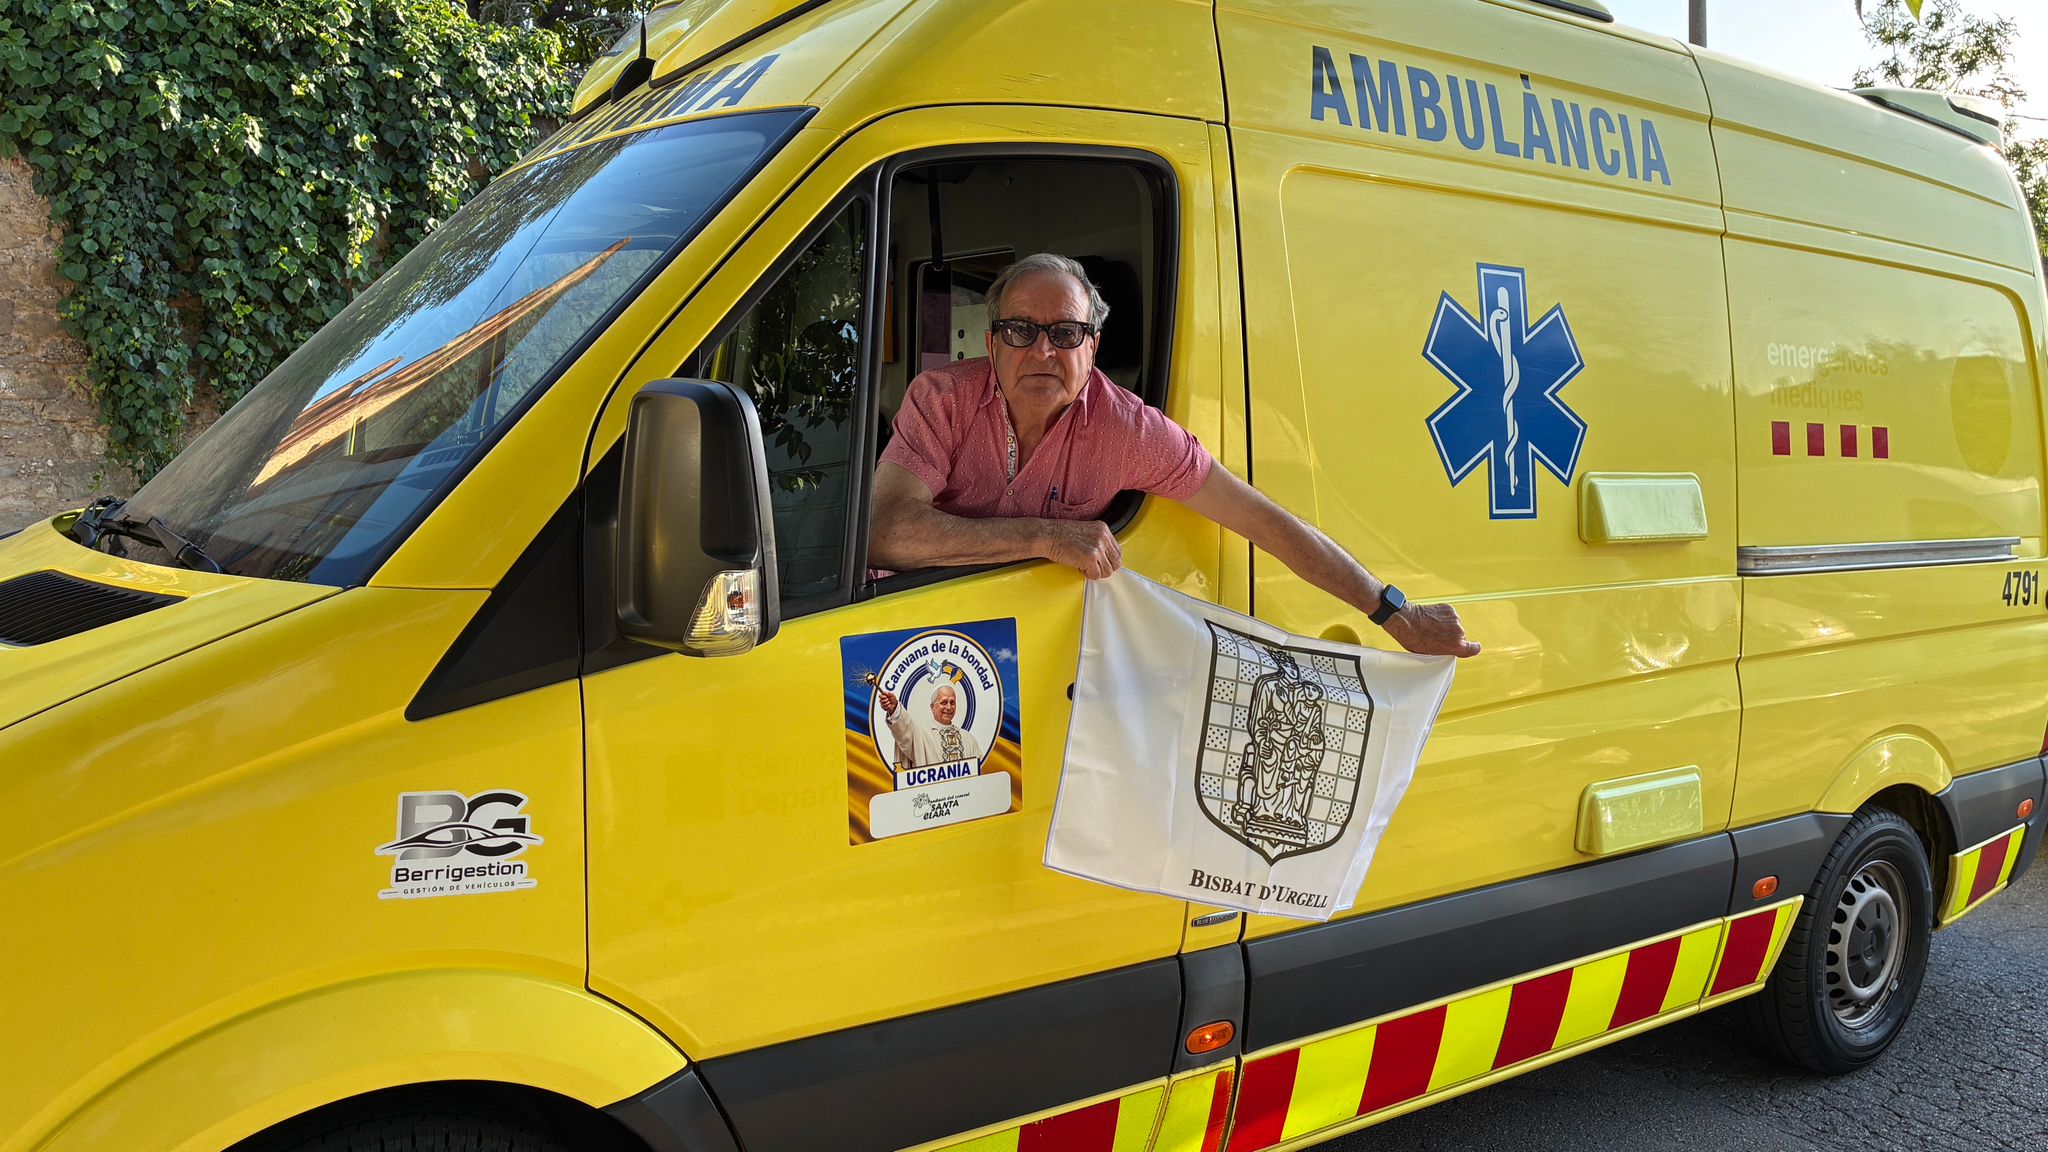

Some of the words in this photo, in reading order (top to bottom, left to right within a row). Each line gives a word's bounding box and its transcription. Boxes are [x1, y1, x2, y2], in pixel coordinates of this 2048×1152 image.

[1310, 45, 1672, 186] AMBULÀNCIA
[2002, 570, 2039, 607] 4791
[885, 644, 929, 692] Caravana
[931, 639, 946, 653] de
[949, 639, 960, 655] la
[960, 645, 994, 691] bondad
[923, 809, 951, 820] CLARA
[931, 800, 959, 813] SANTA
[400, 793, 526, 860] BG
[395, 861, 524, 883] Berrigestion
[1189, 868, 1256, 897] BISBAT
[403, 886, 445, 895] GESTIÓN
[465, 880, 516, 890] VEHÍCULOS
